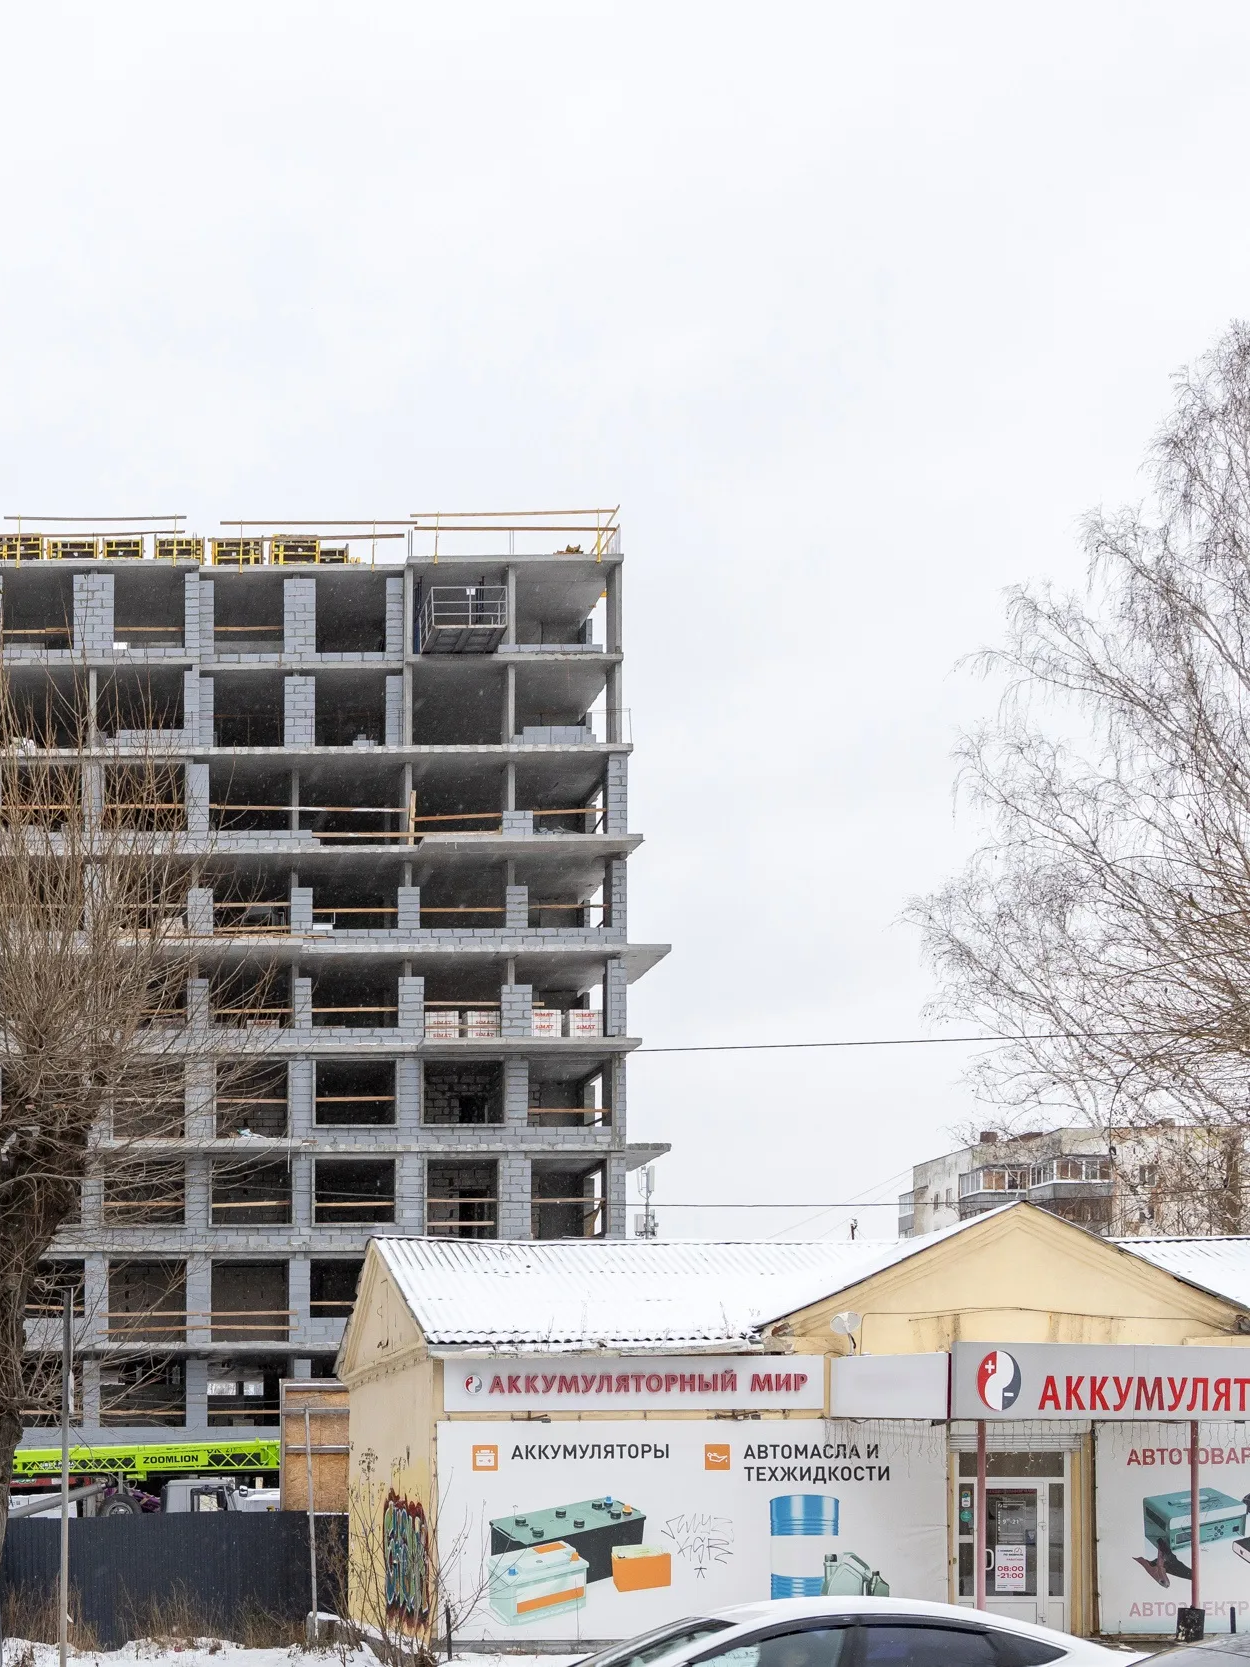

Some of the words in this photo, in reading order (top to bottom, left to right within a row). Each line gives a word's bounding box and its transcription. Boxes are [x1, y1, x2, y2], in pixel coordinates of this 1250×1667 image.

[489, 1369, 738, 1394] АККУМУЛЯТОРНЫЙ
[751, 1373, 808, 1392] МИР
[1038, 1375, 1250, 1412] АККУМУЛЯТ
[143, 1455, 199, 1465] ZOOMLION
[511, 1444, 670, 1461] АККУМУЛЯТОРЫ
[743, 1444, 861, 1461] АВТОМАСЛА
[867, 1443, 880, 1460] И
[743, 1466, 892, 1485] ТЕХЖИДКОСТИ
